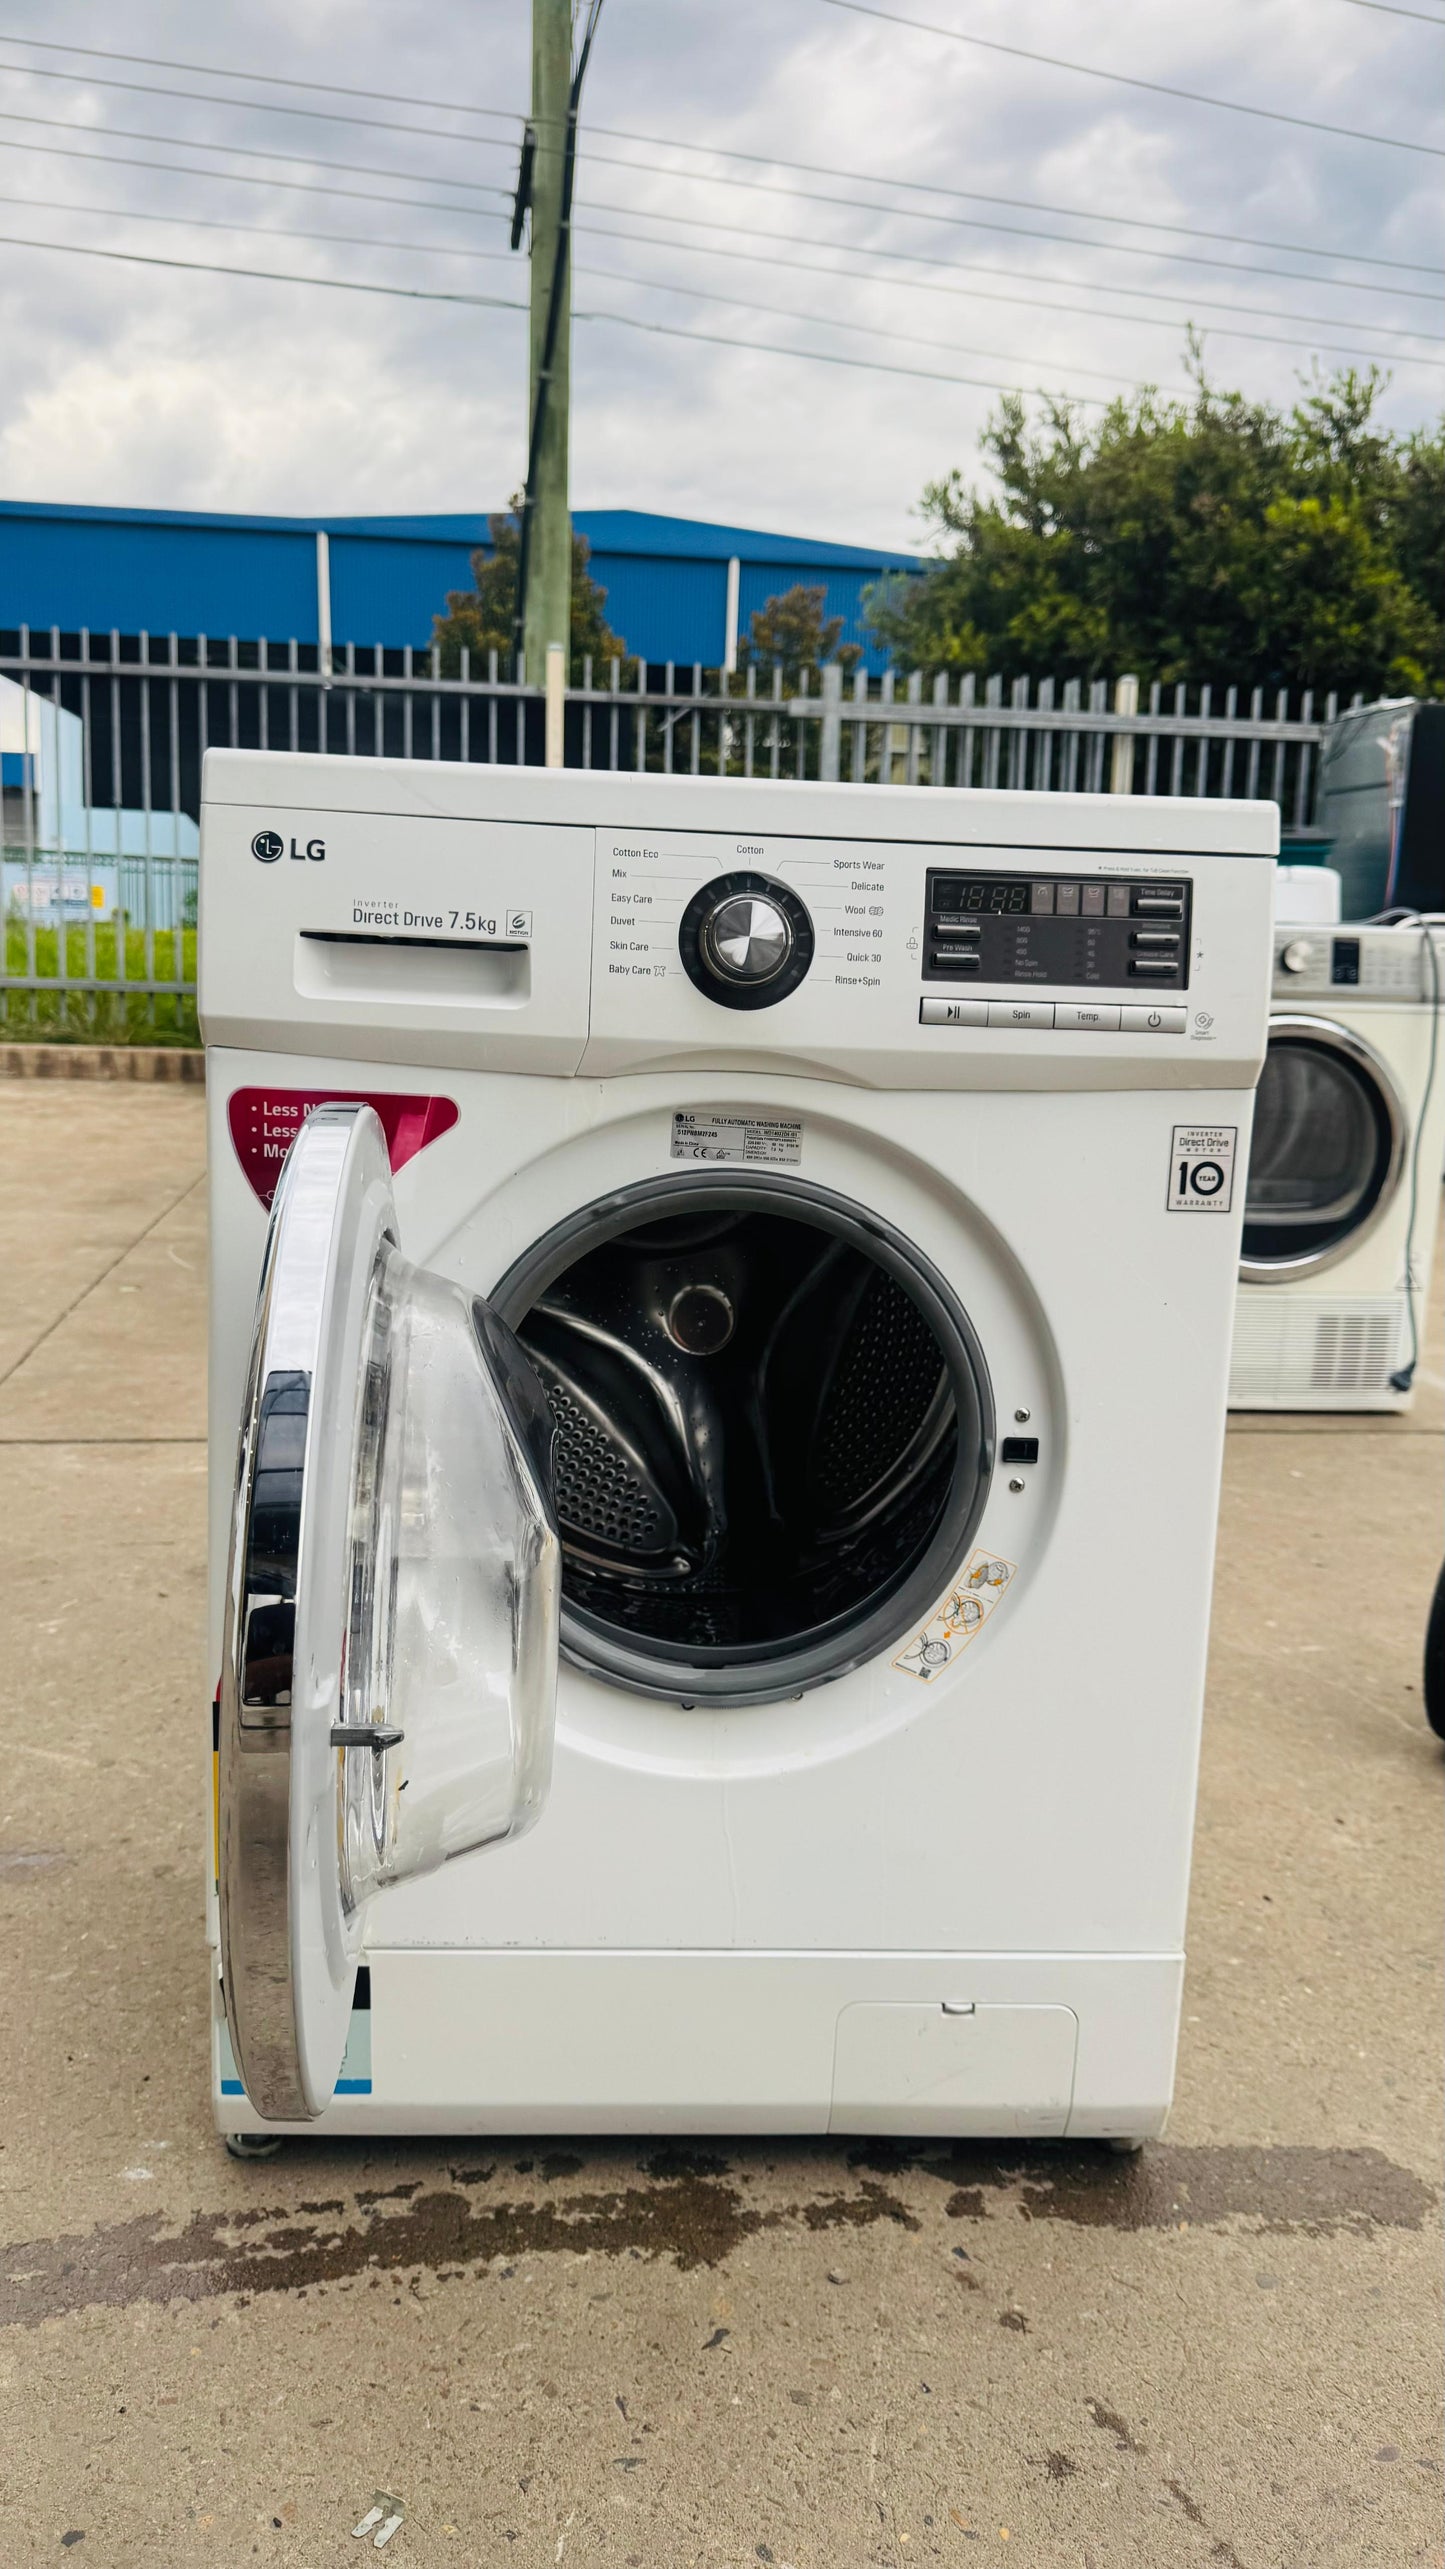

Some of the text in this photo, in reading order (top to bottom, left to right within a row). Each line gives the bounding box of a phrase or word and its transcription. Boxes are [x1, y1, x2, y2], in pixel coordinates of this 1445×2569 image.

[290, 837, 326, 862] LG
[612, 848, 659, 859] Cotton Eco
[736, 844, 764, 855] Cotton
[833, 859, 885, 871] Sports Wear
[612, 869, 627, 878] Mix
[851, 881, 885, 892] Delicate
[353, 898, 400, 909] Inverter
[611, 893, 653, 904] Easy Care
[844, 905, 866, 915] Wool
[352, 908, 497, 934] Direct Drive 7.5kg
[610, 916, 635, 926] Duvet
[940, 915, 978, 924] Medic Rinse
[833, 928, 883, 938] Intensive 60
[609, 941, 649, 951] Skin Care
[955, 944, 973, 952] Wash
[847, 953, 882, 963] Quick 30
[609, 965, 651, 976] Baby Care
[835, 975, 881, 987] Rinse+Spin
[1012, 1009, 1031, 1021] Spin
[1077, 1011, 1101, 1022] Temp.
[263, 1101, 298, 1117] Less
[712, 1117, 727, 1125] FULLY
[727, 1119, 756, 1127] AUTOMATIC
[780, 1122, 801, 1130] MACHINE
[1179, 1137, 1229, 1147] Direct Drive
[263, 1143, 288, 1158] Mo
[1178, 1161, 1225, 1196] 10
[1175, 1199, 1224, 1207] WARRANTY
